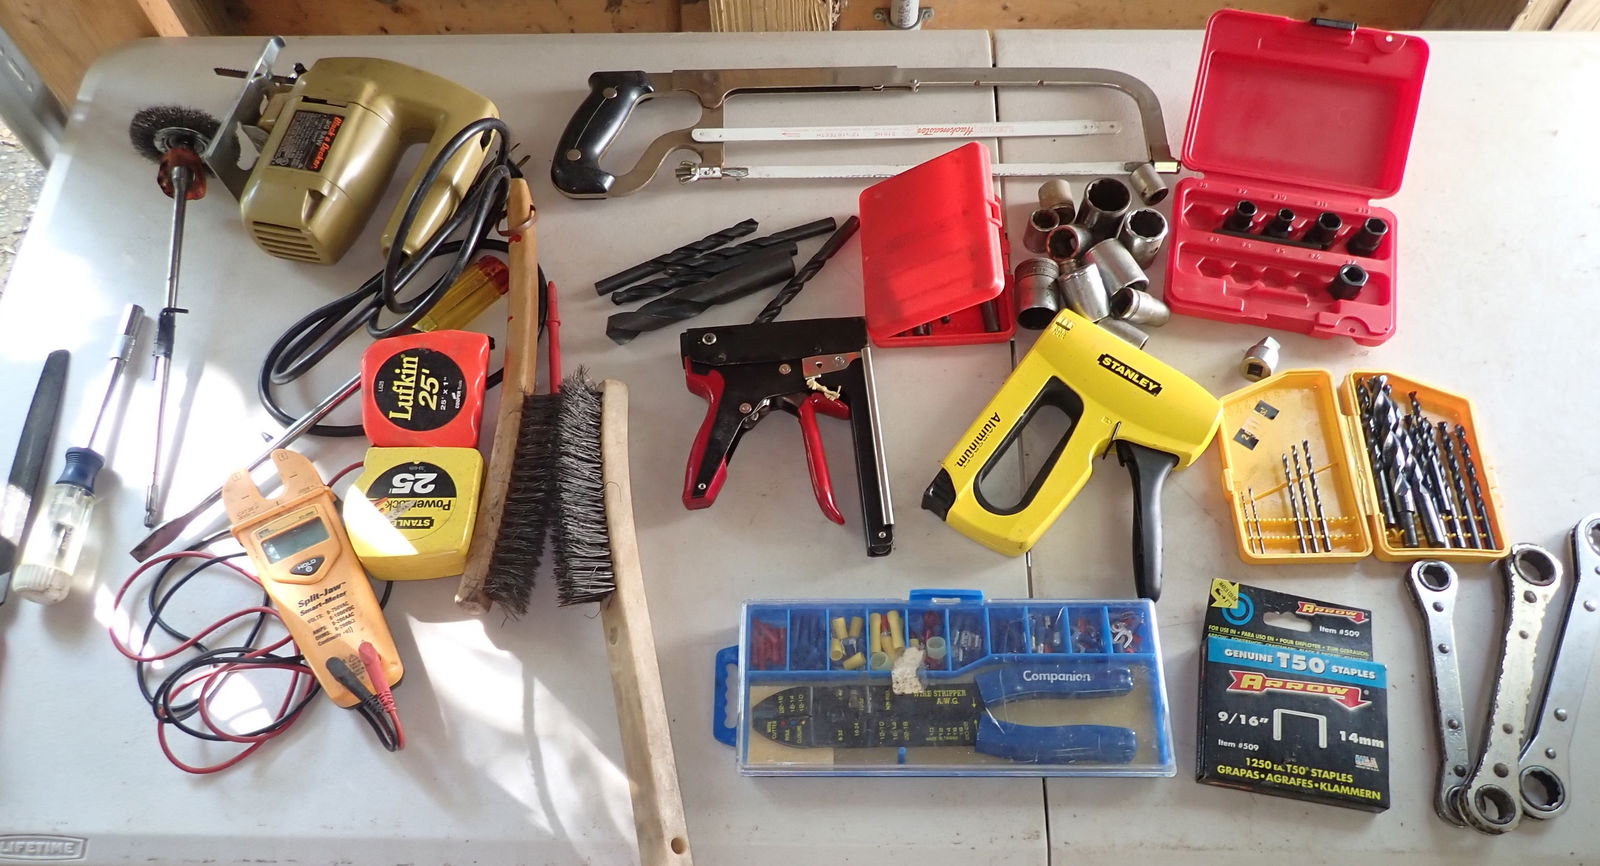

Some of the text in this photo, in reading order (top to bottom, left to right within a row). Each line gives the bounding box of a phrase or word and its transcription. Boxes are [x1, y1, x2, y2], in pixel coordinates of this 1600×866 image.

[328, 116, 343, 137] Black
[916, 126, 975, 137] Hackmaster
[312, 142, 331, 169] Decker
[1102, 357, 1160, 392] STANLEY
[388, 356, 419, 421] Lufkin
[418, 368, 440, 411] 25'
[956, 412, 1001, 468] Aluminum
[385, 499, 452, 511] Powerock
[391, 519, 431, 527] STANLE
[297, 558, 317, 571] HOLD
[300, 590, 348, 617] Smart-Meter
[1208, 624, 1221, 633] FOR
[1220, 626, 1229, 634] USE
[1241, 630, 1255, 639] PARA
[1255, 632, 1266, 641] USO
[1279, 636, 1294, 646] POUR
[1319, 625, 1361, 638] Item #509
[1224, 648, 1273, 663] GENUINE
[1331, 664, 1376, 680] STAPLES
[1023, 670, 1091, 684] Companion
[1217, 711, 1270, 727] 9/16"
[1218, 738, 1259, 752] Item #509
[1339, 730, 1385, 749] 14mm
[1246, 757, 1272, 770] 1250
[1311, 768, 1353, 783] STAPLES
[1216, 764, 1381, 801] GRAPAS AGRAFES KLAMMERN
[0, 841, 75, 855] LIFETIME
